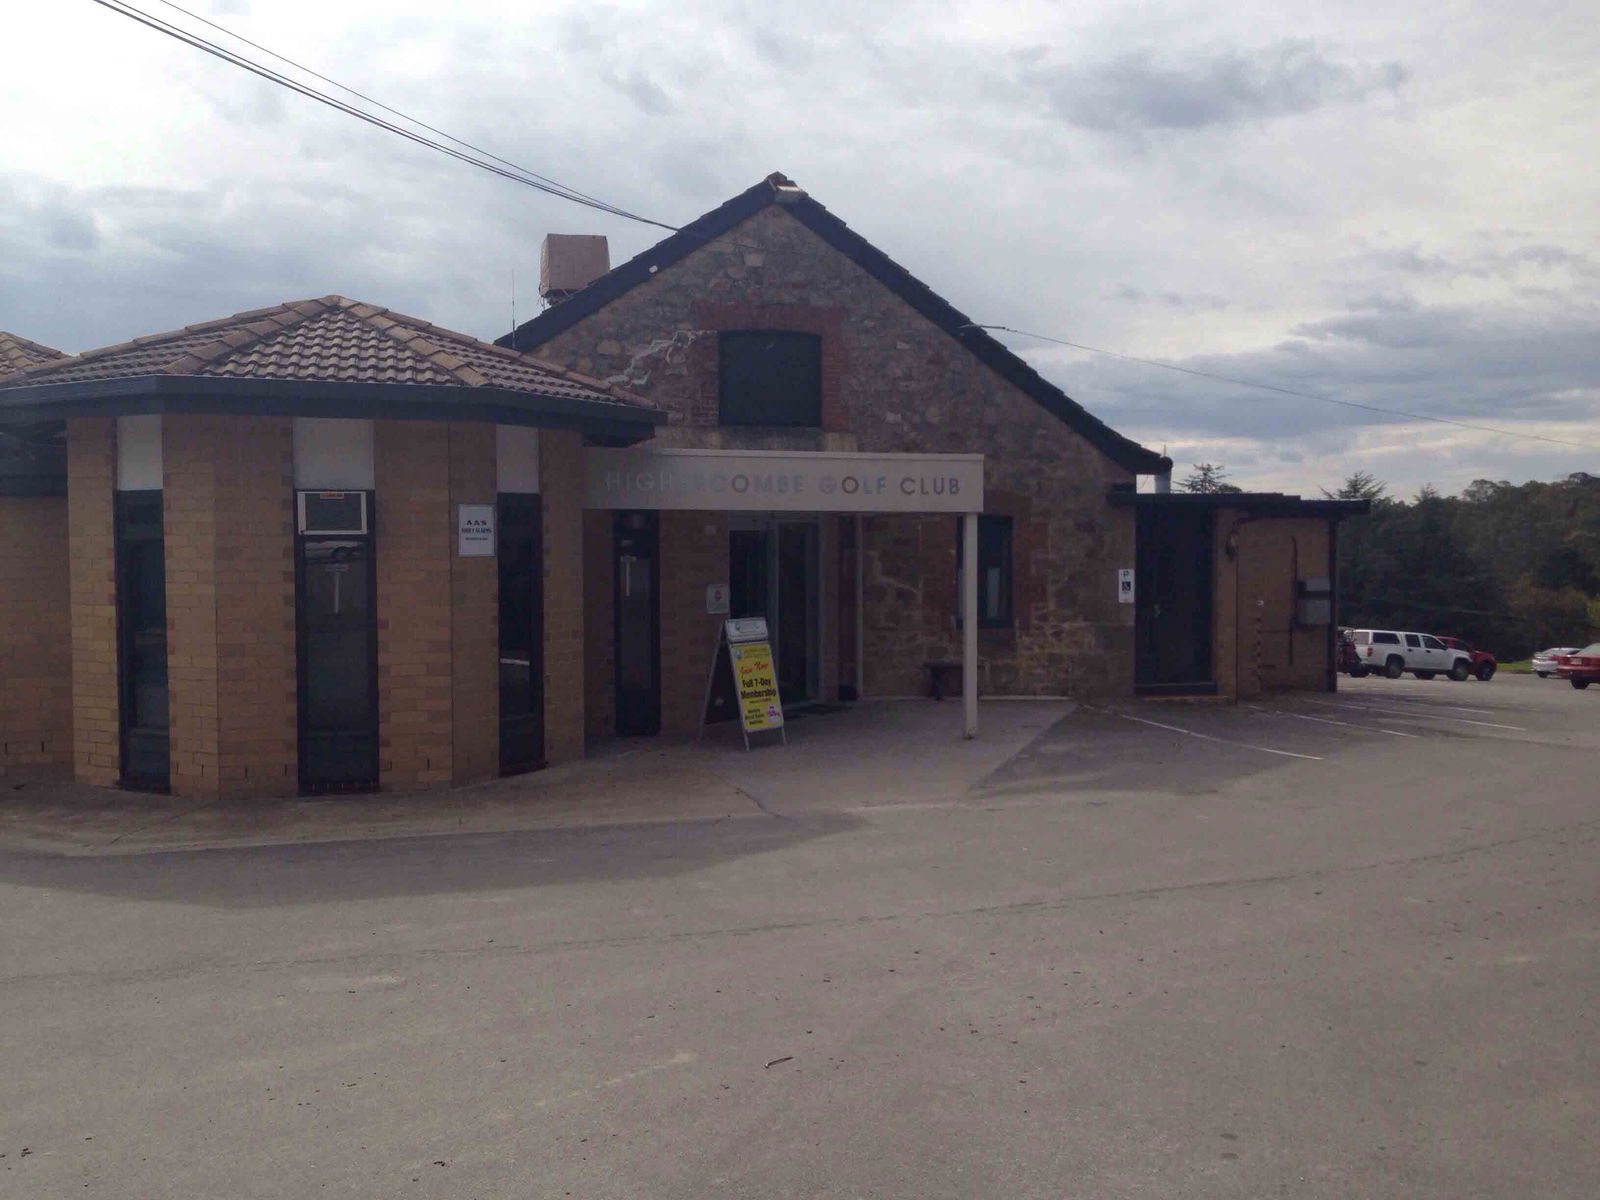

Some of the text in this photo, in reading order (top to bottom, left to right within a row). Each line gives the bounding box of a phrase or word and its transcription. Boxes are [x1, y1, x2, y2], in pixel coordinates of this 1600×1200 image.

[606, 471, 960, 495] HIGHCOMBE GOLF CLUB
[742, 679, 753, 688] Full
[741, 688, 776, 699] Membership
